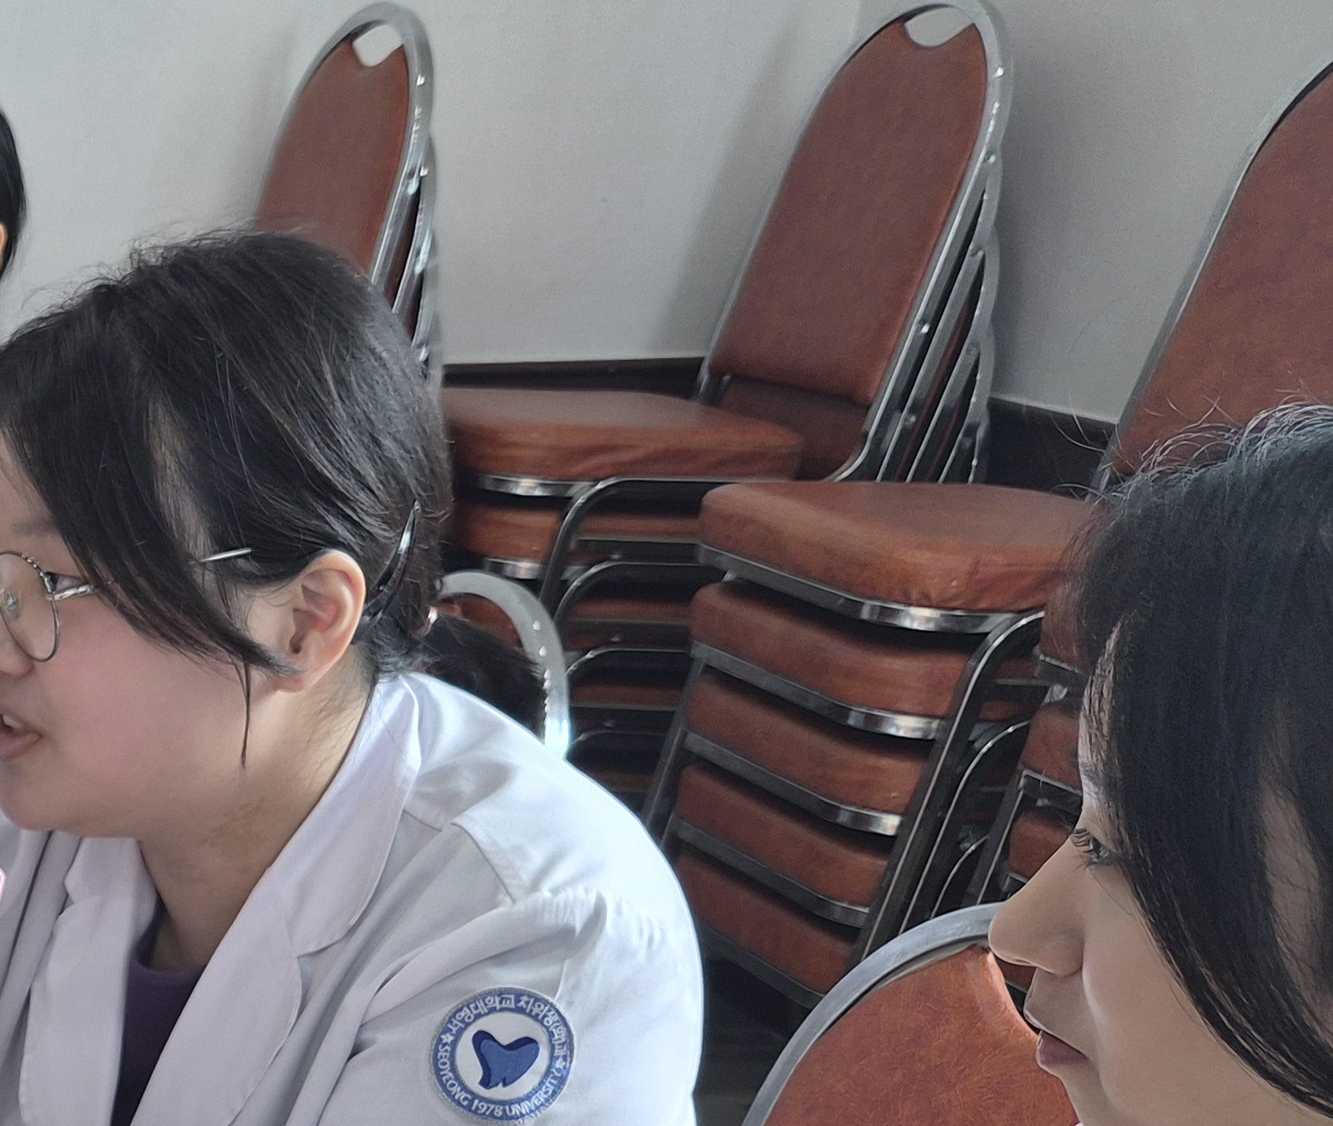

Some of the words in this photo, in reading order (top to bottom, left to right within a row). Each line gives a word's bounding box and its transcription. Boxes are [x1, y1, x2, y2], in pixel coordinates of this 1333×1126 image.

[445, 993, 516, 1034] 서영대학교
[517, 995, 570, 1059] 치위생학과
[437, 1044, 471, 1108] SEOYEONG
[470, 1097, 504, 1118] 1978
[505, 1066, 563, 1118] UNIVERSITY
